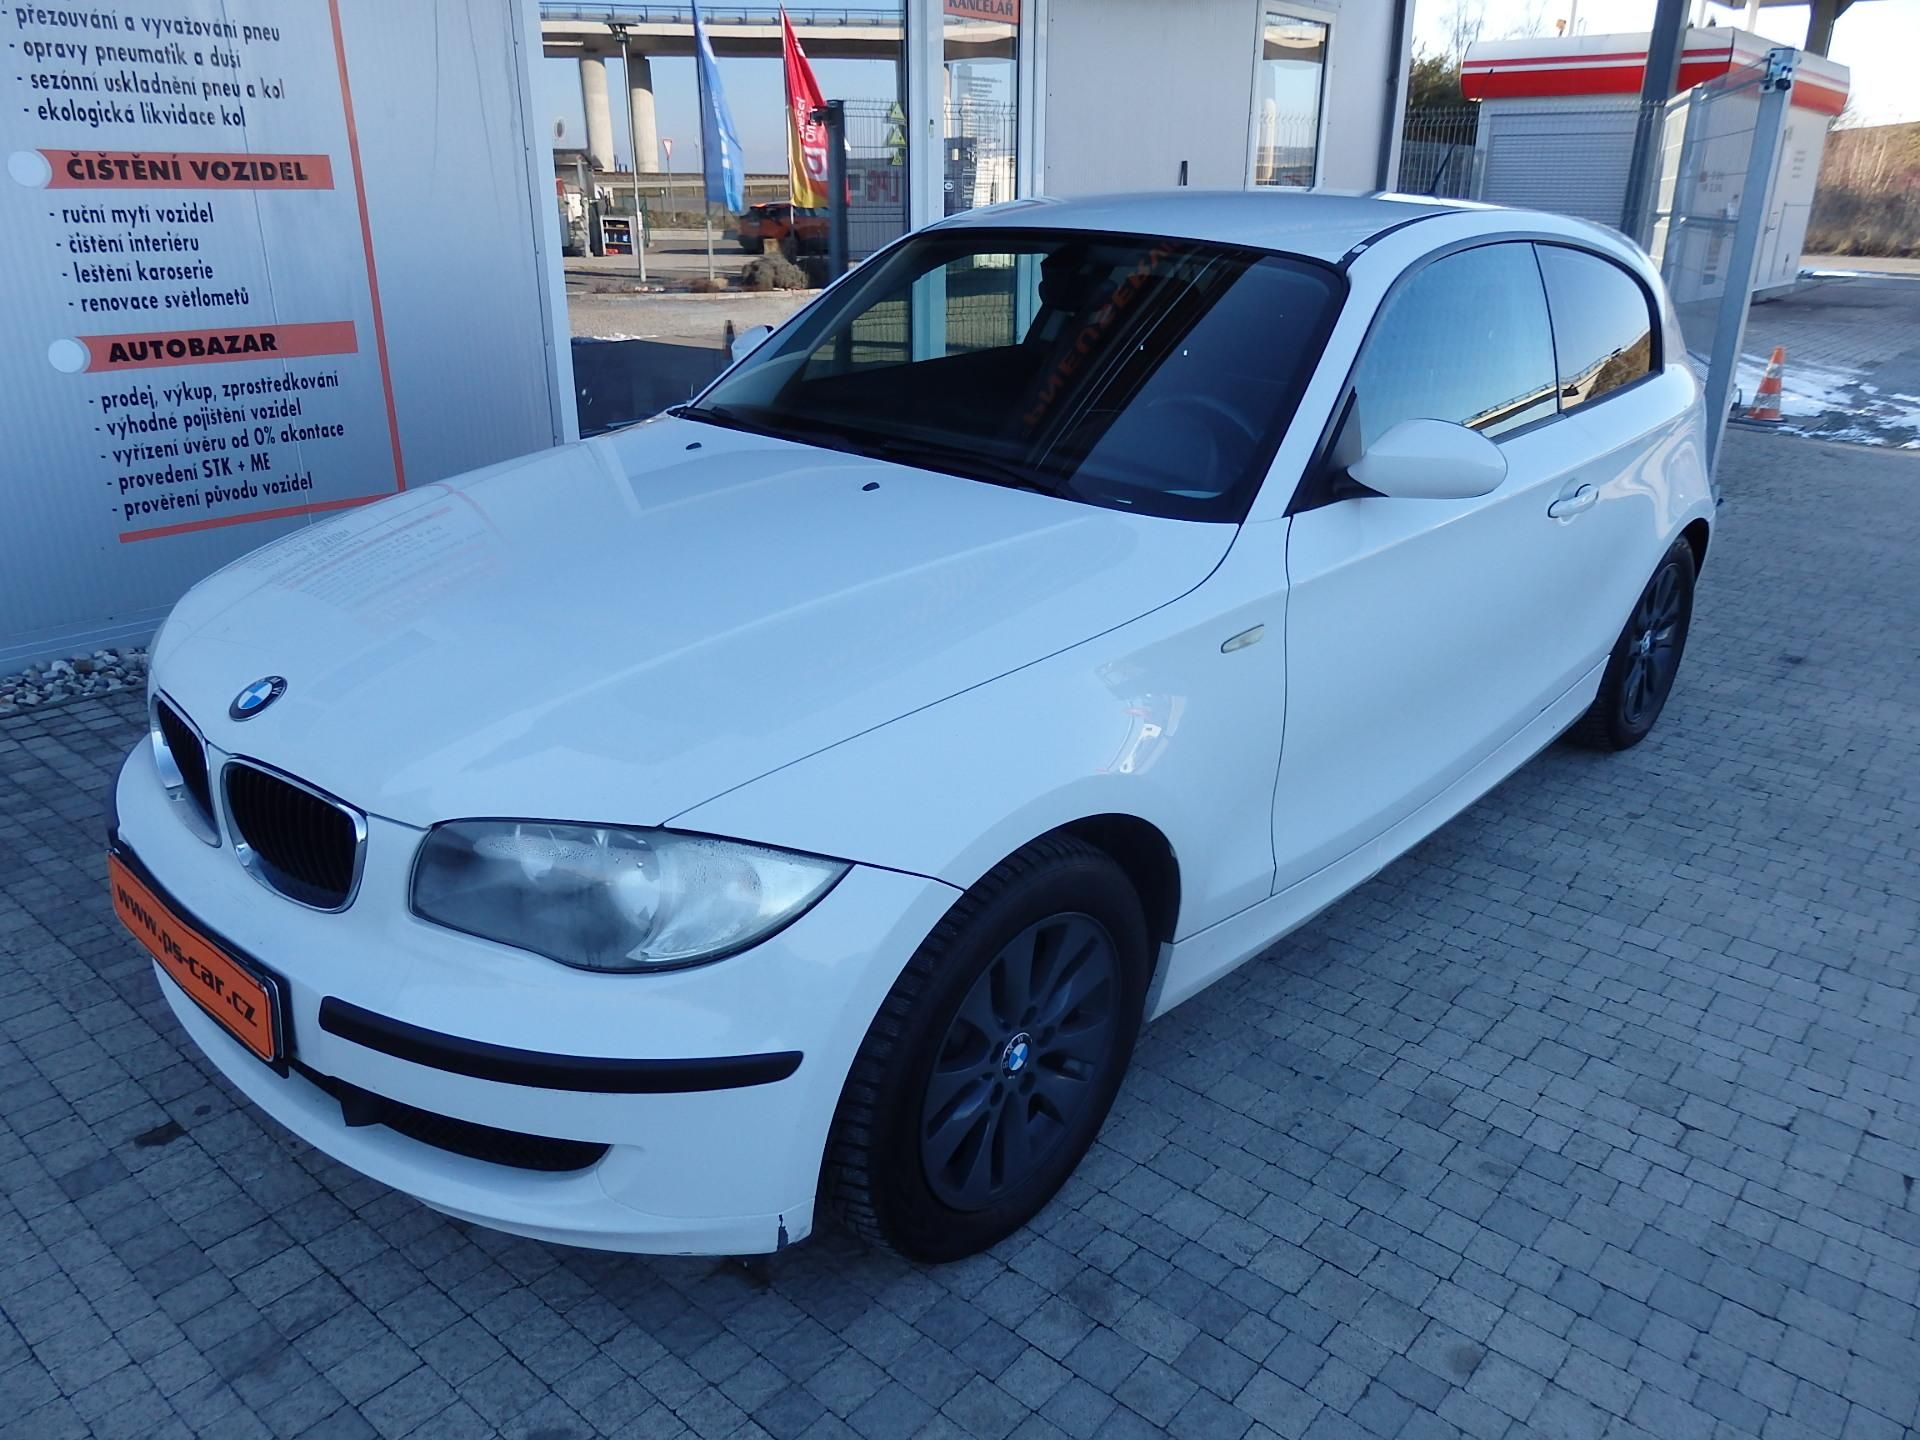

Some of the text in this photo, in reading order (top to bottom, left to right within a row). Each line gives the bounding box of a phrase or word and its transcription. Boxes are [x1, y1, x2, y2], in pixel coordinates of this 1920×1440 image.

[16, 3, 118, 30] přezouvání
[125, 17, 135, 31] a
[141, 16, 238, 39] vyvažování
[243, 25, 280, 45] pneu
[24, 41, 87, 66] opravy
[96, 42, 188, 66] pneumatik
[194, 52, 204, 66] a
[210, 45, 241, 68] duší
[31, 69, 99, 91] sezónní
[104, 70, 197, 95] uskladnění
[202, 82, 241, 101] pneu
[246, 84, 256, 97] a
[260, 77, 285, 99] kol
[38, 97, 135, 128] ekologická
[140, 101, 215, 125] likvidace
[220, 104, 246, 127] kol
[67, 151, 309, 182] ČIŠTĚNÍ VOZIDEL
[63, 203, 106, 223] ruční
[112, 203, 151, 228] mytí
[156, 202, 214, 223] vozidel
[69, 232, 124, 253] čištění
[128, 232, 199, 252] interiéru
[74, 261, 132, 283] leštění
[136, 259, 213, 281] karoserie
[81, 295, 158, 312] renovace
[165, 287, 249, 308] světlometů
[109, 333, 278, 363] AUTOBAZAR
[101, 385, 158, 414] prodej,
[163, 381, 217, 407] výkup,
[222, 370, 339, 401] zprostředkování
[107, 412, 178, 441] výhodné
[183, 405, 246, 433] pojištění
[251, 397, 302, 420] vozidel
[113, 439, 179, 467] vyřízení
[183, 436, 227, 454] úvěru
[232, 428, 249, 448] od
[254, 425, 276, 446] 0%
[281, 424, 344, 443] akontace
[119, 463, 198, 495] provedení
[202, 457, 233, 478] STK
[251, 452, 271, 472] ME
[124, 489, 200, 521] prověření
[205, 480, 258, 508] původu
[263, 472, 313, 495] vozidel
